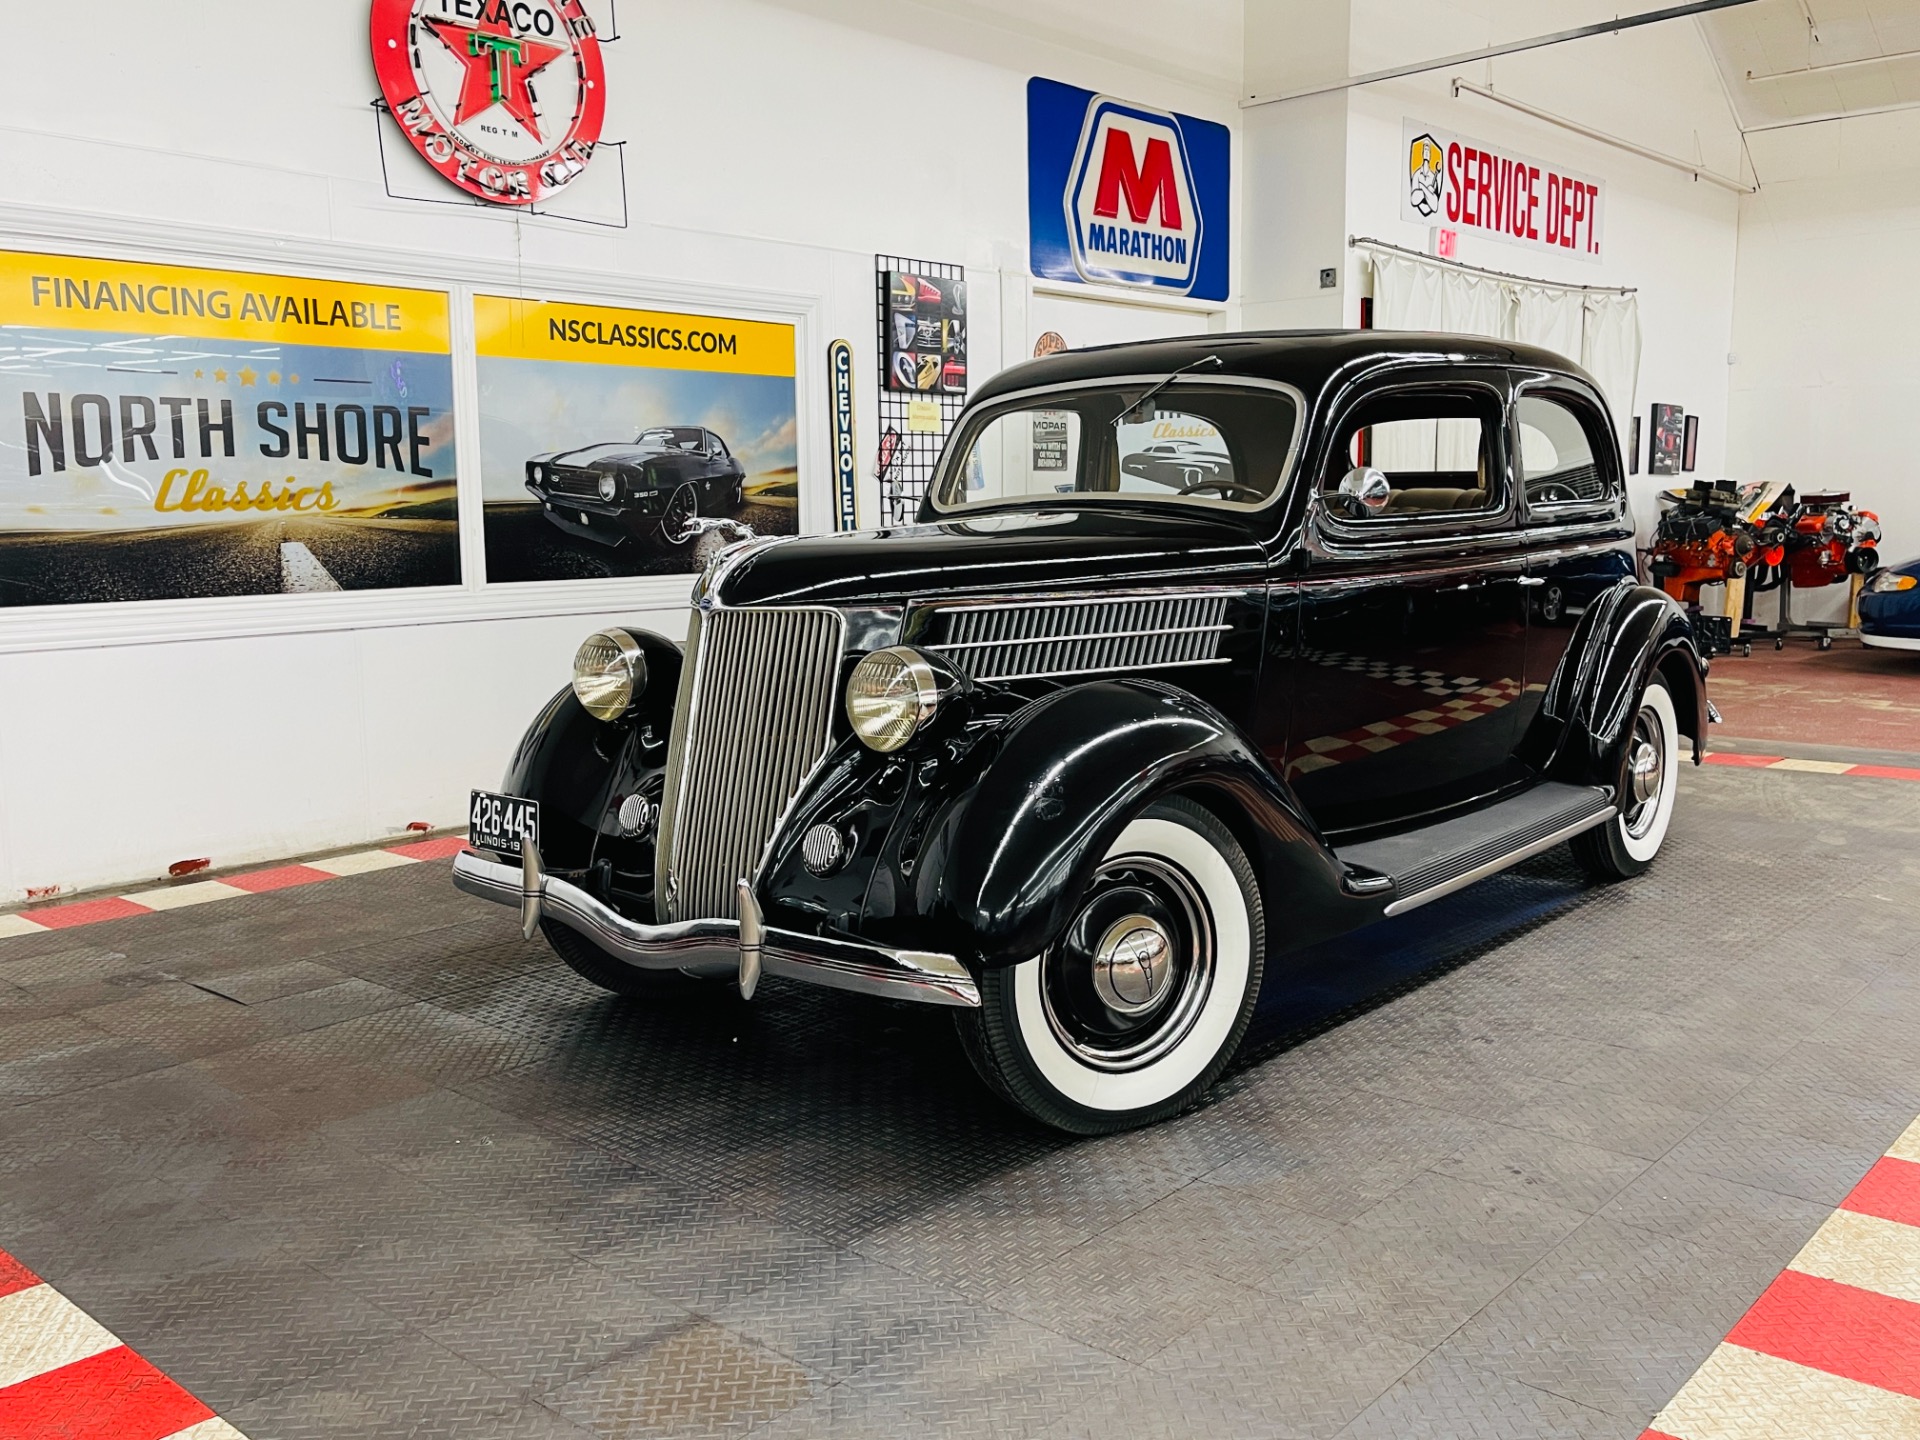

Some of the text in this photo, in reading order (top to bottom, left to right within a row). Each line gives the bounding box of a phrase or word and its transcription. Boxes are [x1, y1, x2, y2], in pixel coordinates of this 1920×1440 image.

[396, 96, 531, 200] MOTOR
[481, 125, 498, 134] REG
[1093, 127, 1182, 231] M
[1446, 142, 1599, 255] SERVICE DEPT.
[1088, 223, 1187, 265] MARATHON
[1438, 229, 1457, 257] EXIT
[31, 275, 402, 331] FINANCING AVAILABLE
[549, 318, 737, 355] NSCLASSICS.COM
[22, 391, 434, 478] NORTH SHORE
[836, 351, 854, 531] CHEVROLET
[1033, 421, 1067, 430] MOPAR
[1152, 422, 1217, 438] Classics
[154, 468, 341, 514] Classics
